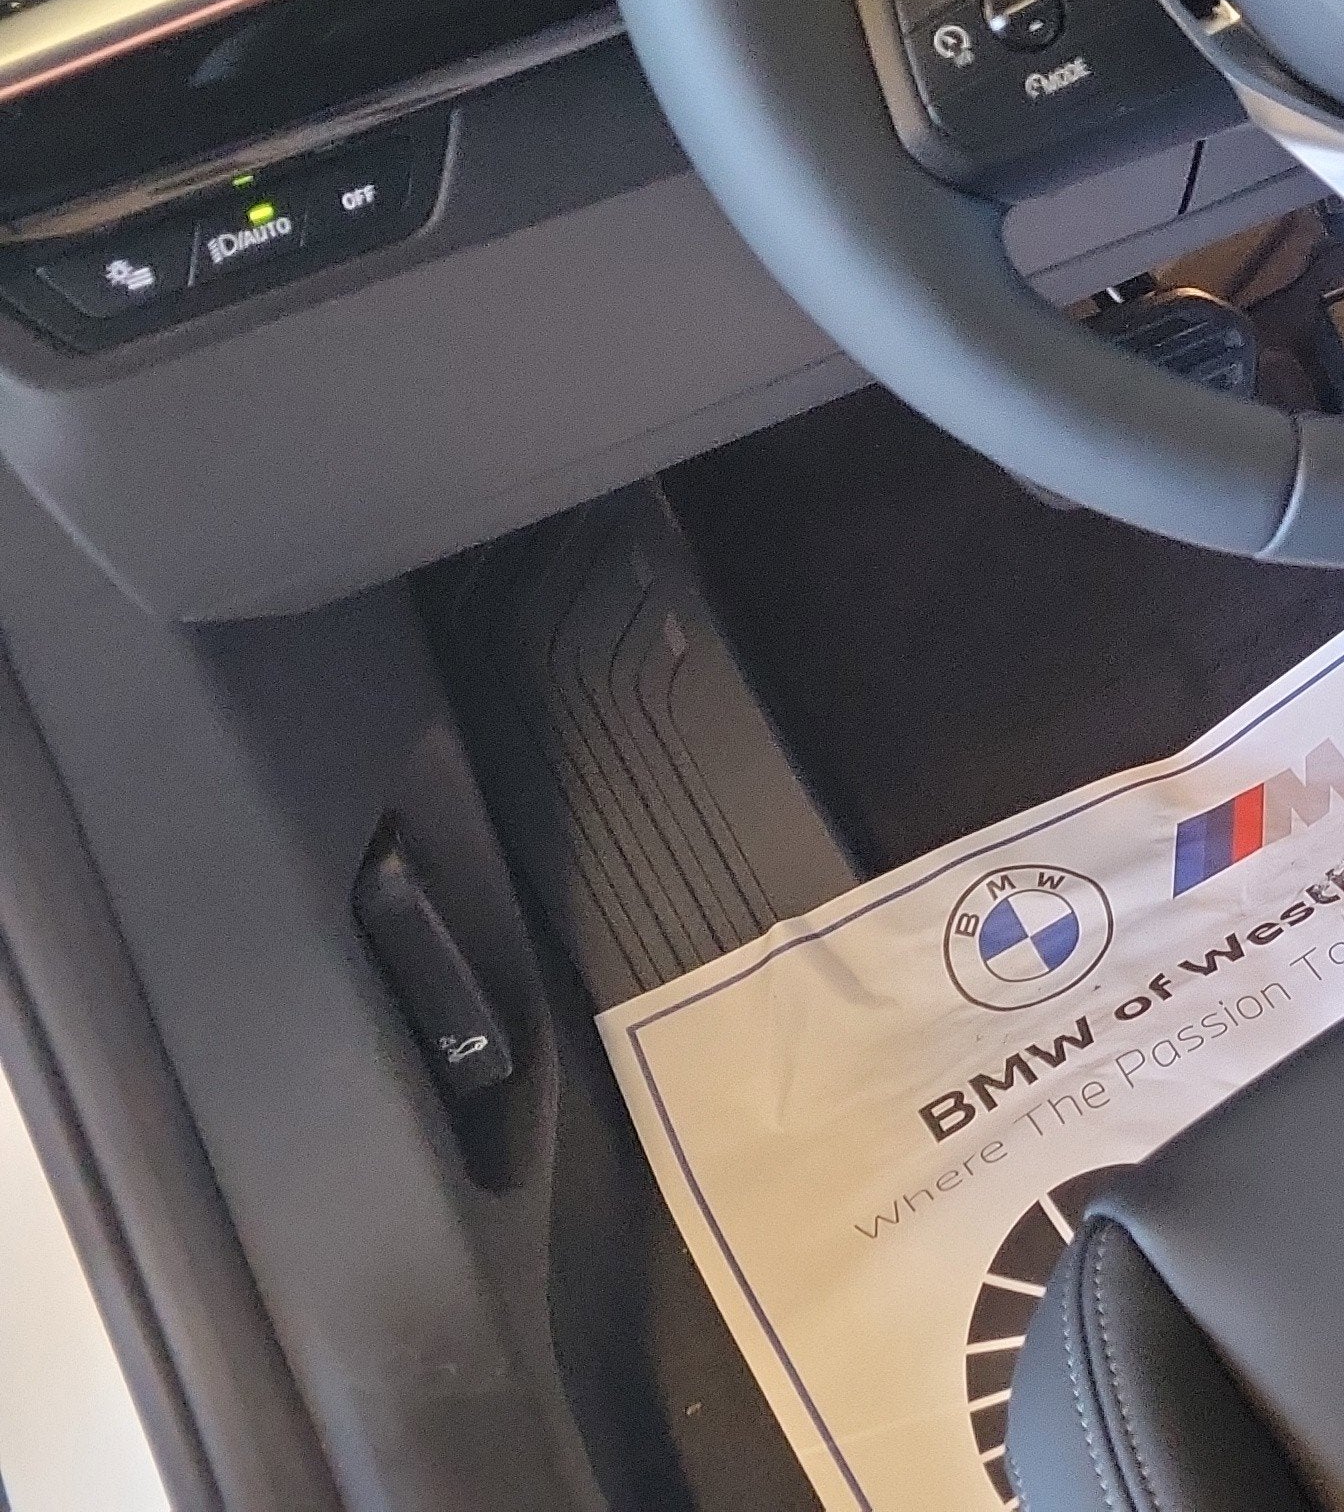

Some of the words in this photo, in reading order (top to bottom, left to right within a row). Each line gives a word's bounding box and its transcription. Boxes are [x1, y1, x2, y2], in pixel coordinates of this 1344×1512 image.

[341, 184, 376, 210] OFF
[954, 871, 1065, 938] BMW
[854, 1140, 1008, 1240] Where
[1013, 1080, 1111, 1136] The
[1115, 981, 1292, 1089] Passion
[918, 1016, 1094, 1144] BMW
[1114, 972, 1173, 1022] of
